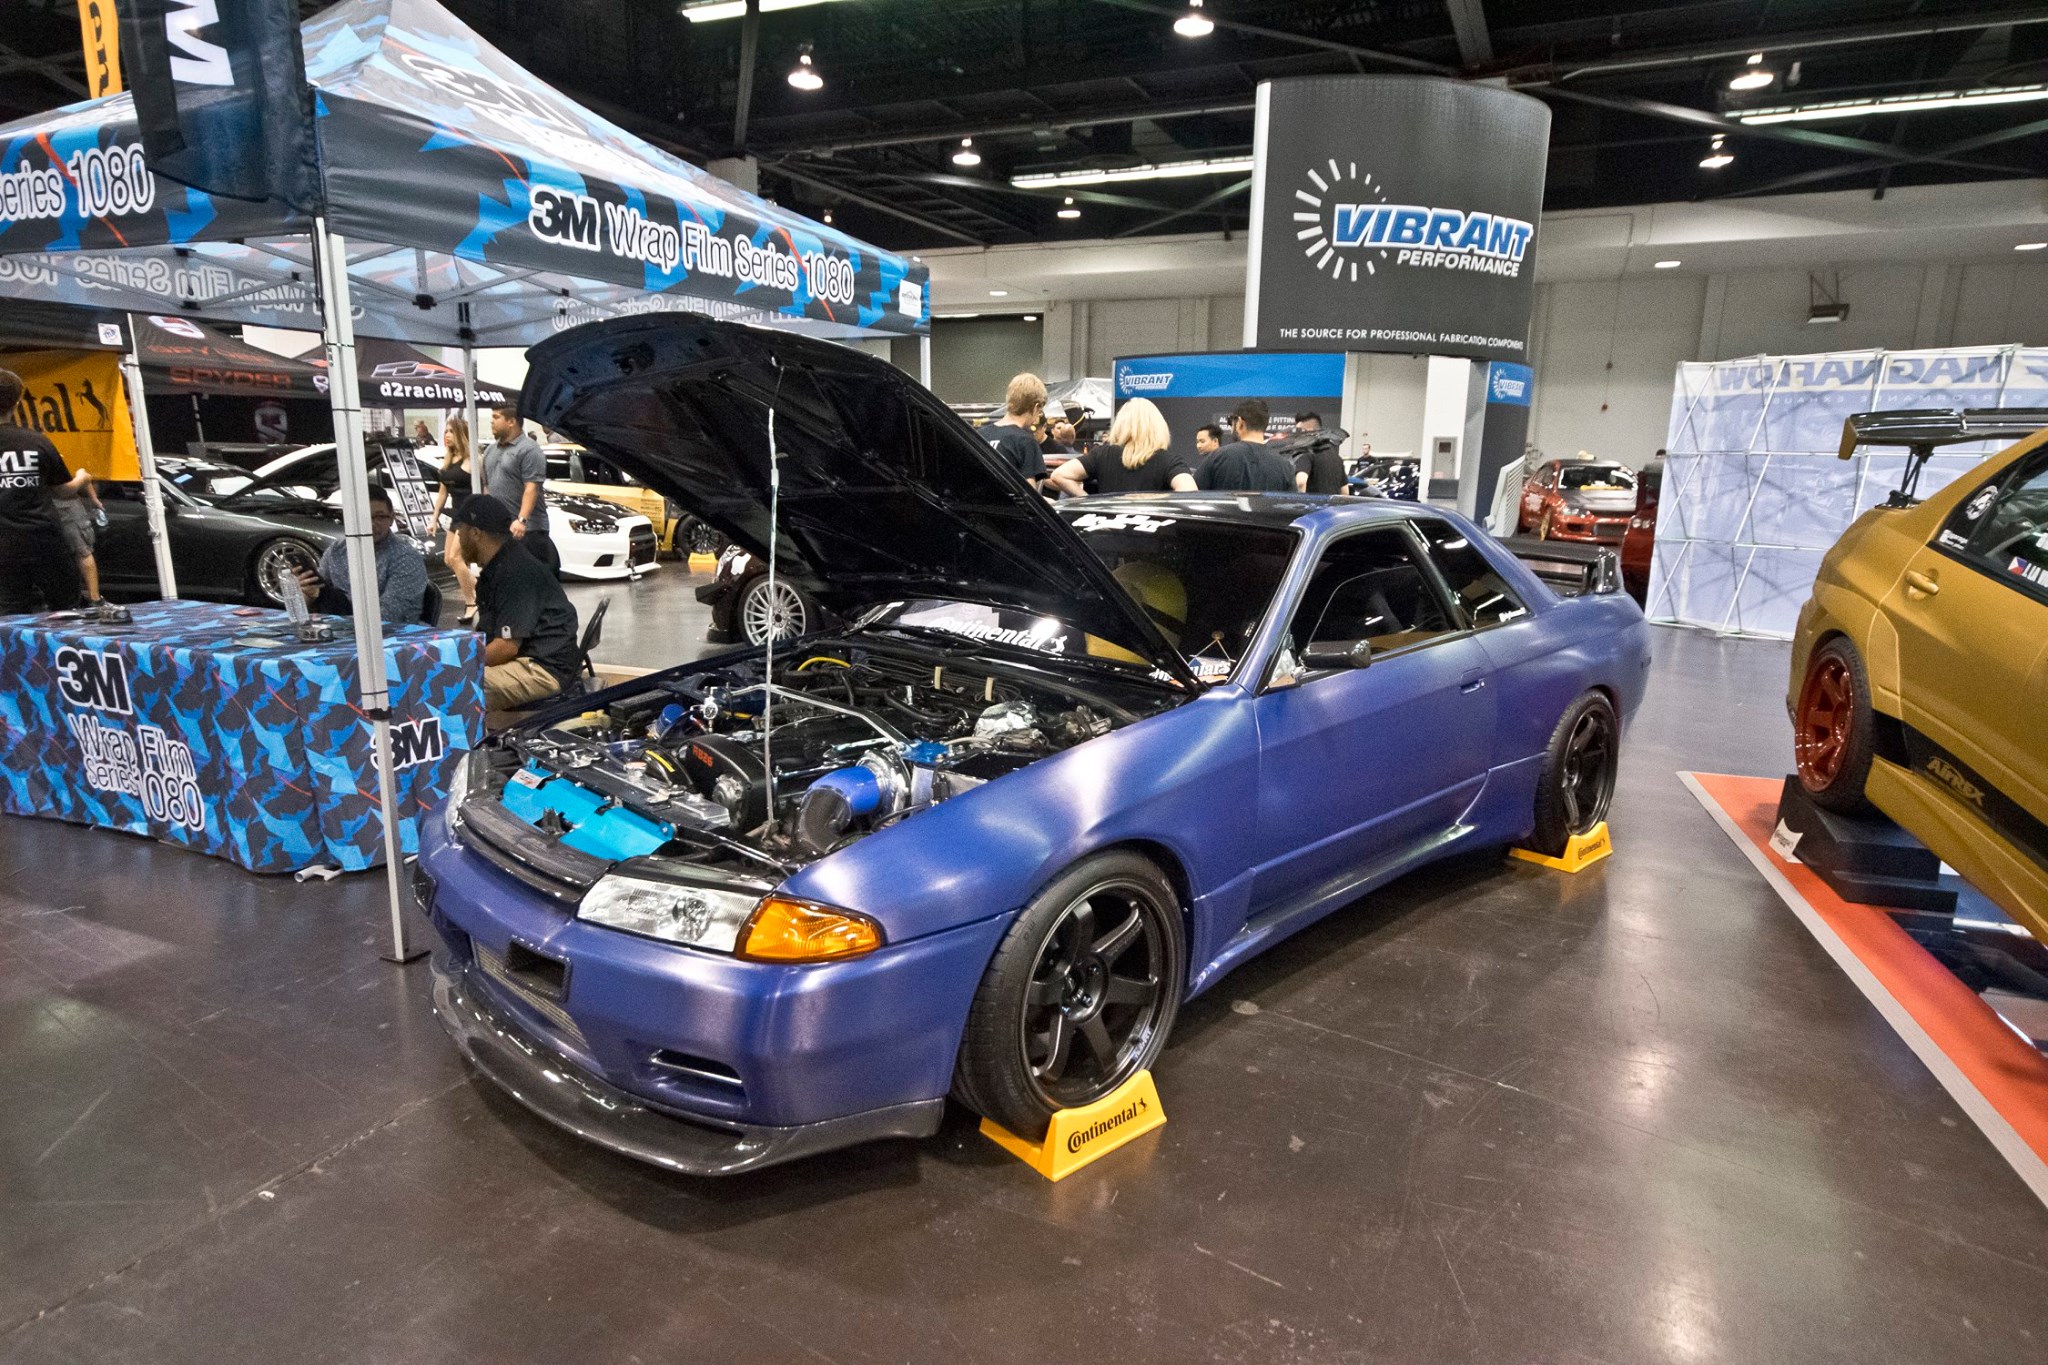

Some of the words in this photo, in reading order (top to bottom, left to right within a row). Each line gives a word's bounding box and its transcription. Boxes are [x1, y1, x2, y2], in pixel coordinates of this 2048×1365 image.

[0, 162, 65, 221] eries
[67, 143, 155, 217] 1080
[530, 187, 600, 249] 3M
[605, 202, 678, 272] Wrap
[683, 222, 732, 276] Film
[736, 234, 798, 289] Series
[803, 251, 855, 304] 1080
[1333, 203, 1533, 262] VIBRANT
[1397, 249, 1519, 277] PERFORMANCE
[1280, 328, 1298, 338] THE
[1301, 328, 1343, 339] SOURCE
[1346, 329, 1367, 339] FOR
[1370, 329, 1437, 342] PROFESSIONAL
[1440, 333, 1487, 345] FABRICATION
[170, 367, 292, 390] SPYDER
[1124, 373, 1173, 386] VIBRANT
[56, 646, 132, 714] 3M
[68, 714, 137, 768] Wrap
[137, 725, 197, 780] Film
[370, 717, 442, 771] 3M
[84, 755, 141, 796] Series
[1067, 1101, 1138, 1154] Continental
